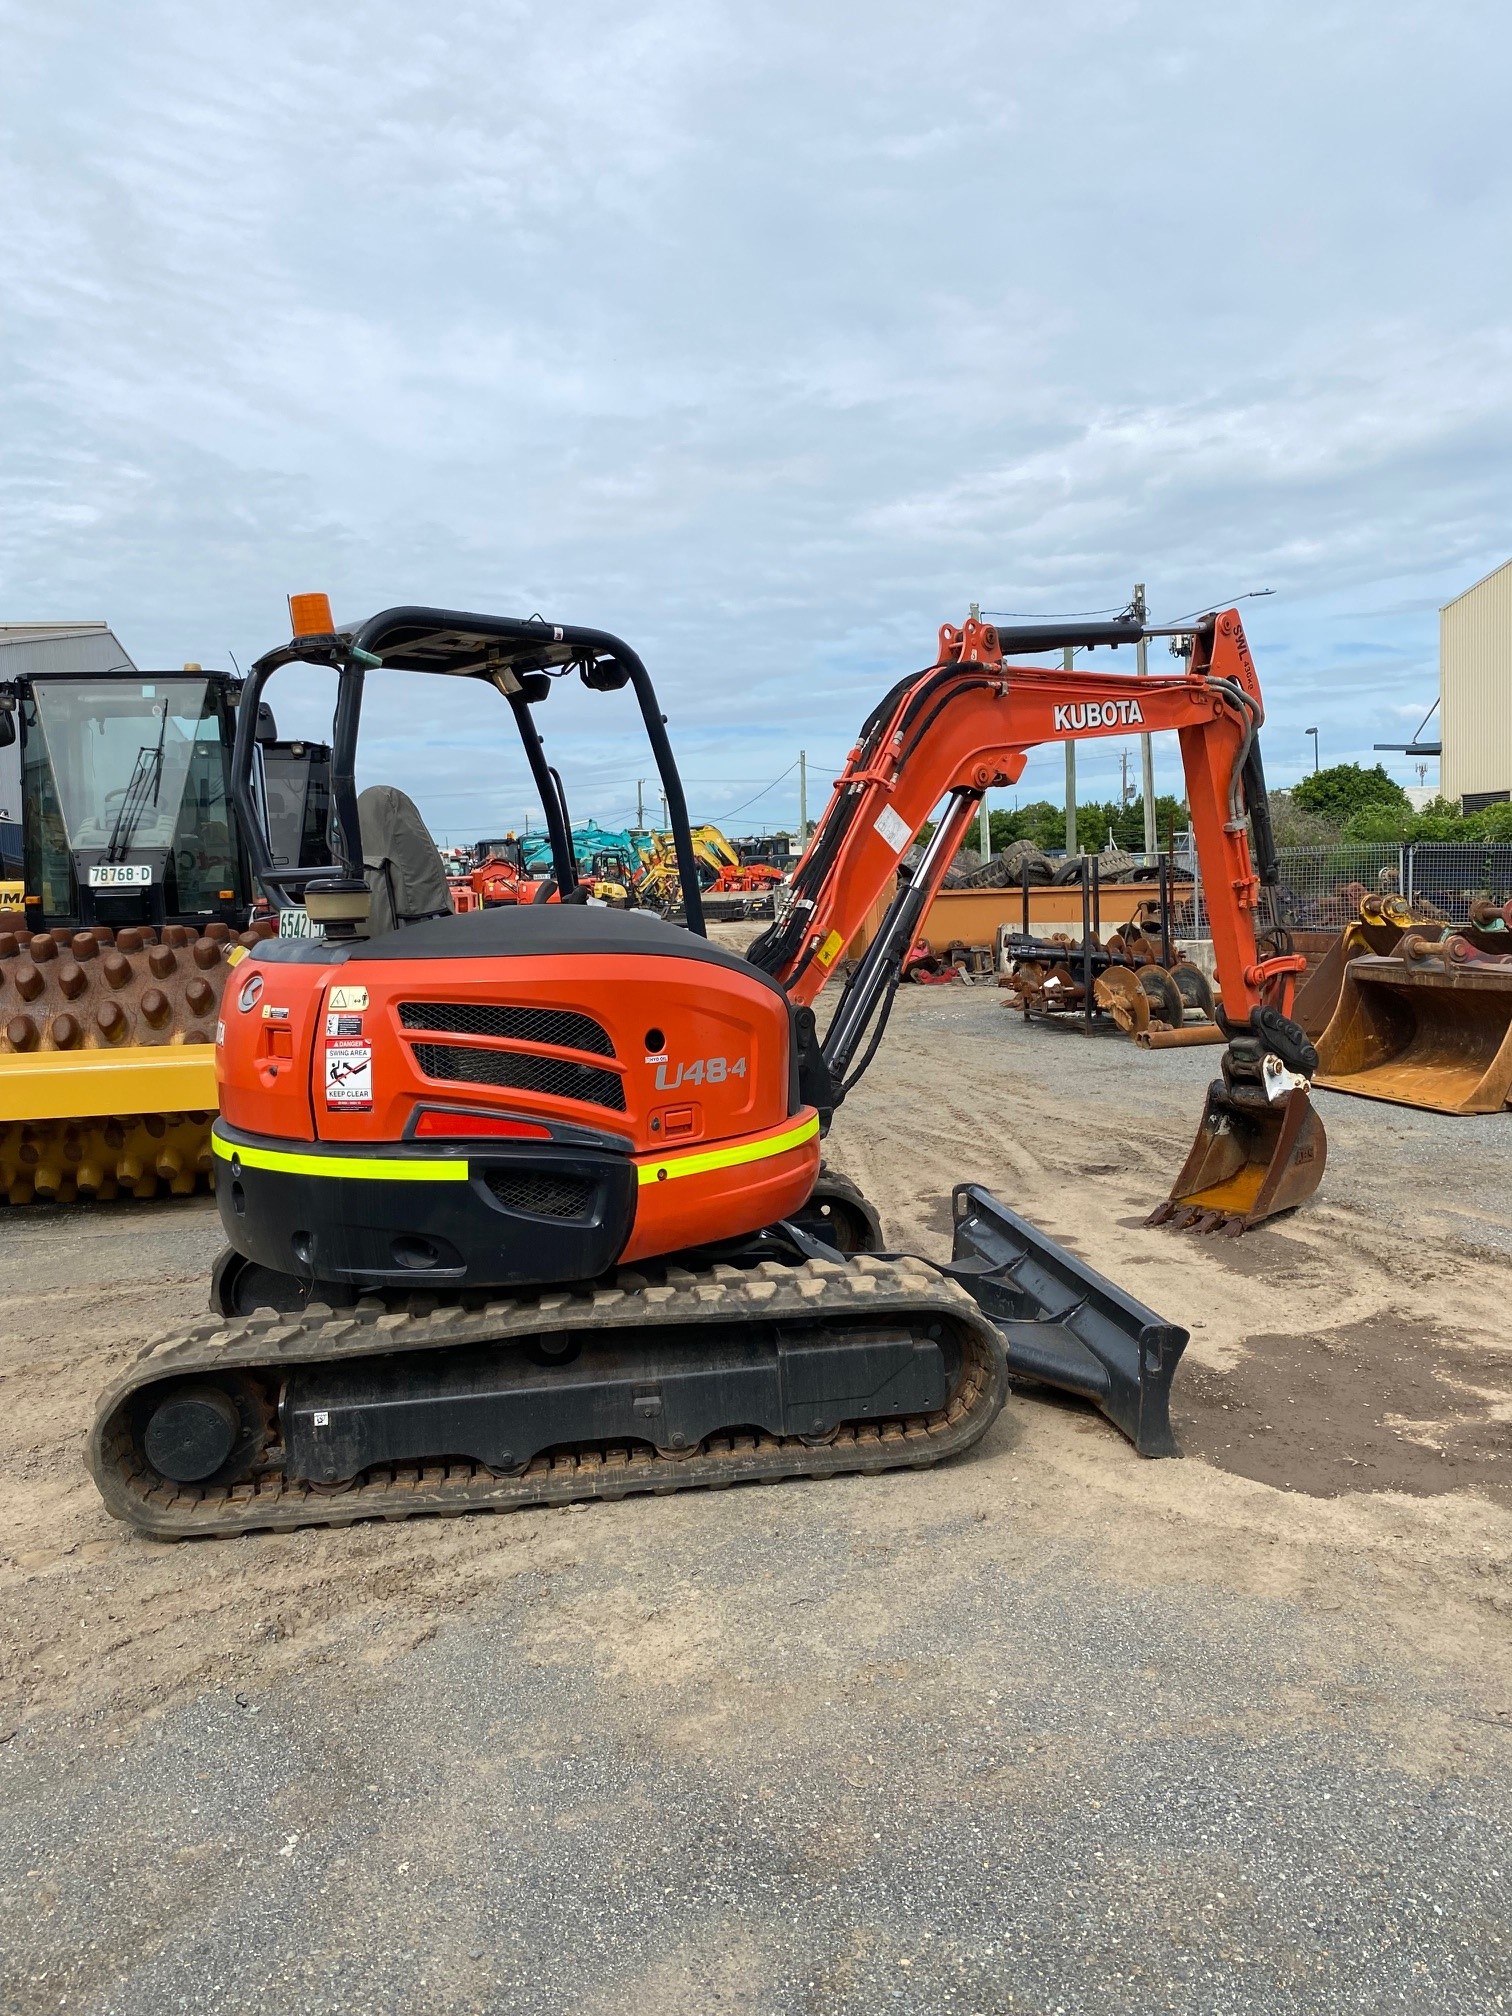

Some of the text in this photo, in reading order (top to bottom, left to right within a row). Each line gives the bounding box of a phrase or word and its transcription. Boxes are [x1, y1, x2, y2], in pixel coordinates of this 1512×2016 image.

[1233, 624, 1248, 661] SWL
[1053, 700, 1144, 731] KUBOTA
[328, 1090, 369, 1098] KEEP CLEAR
